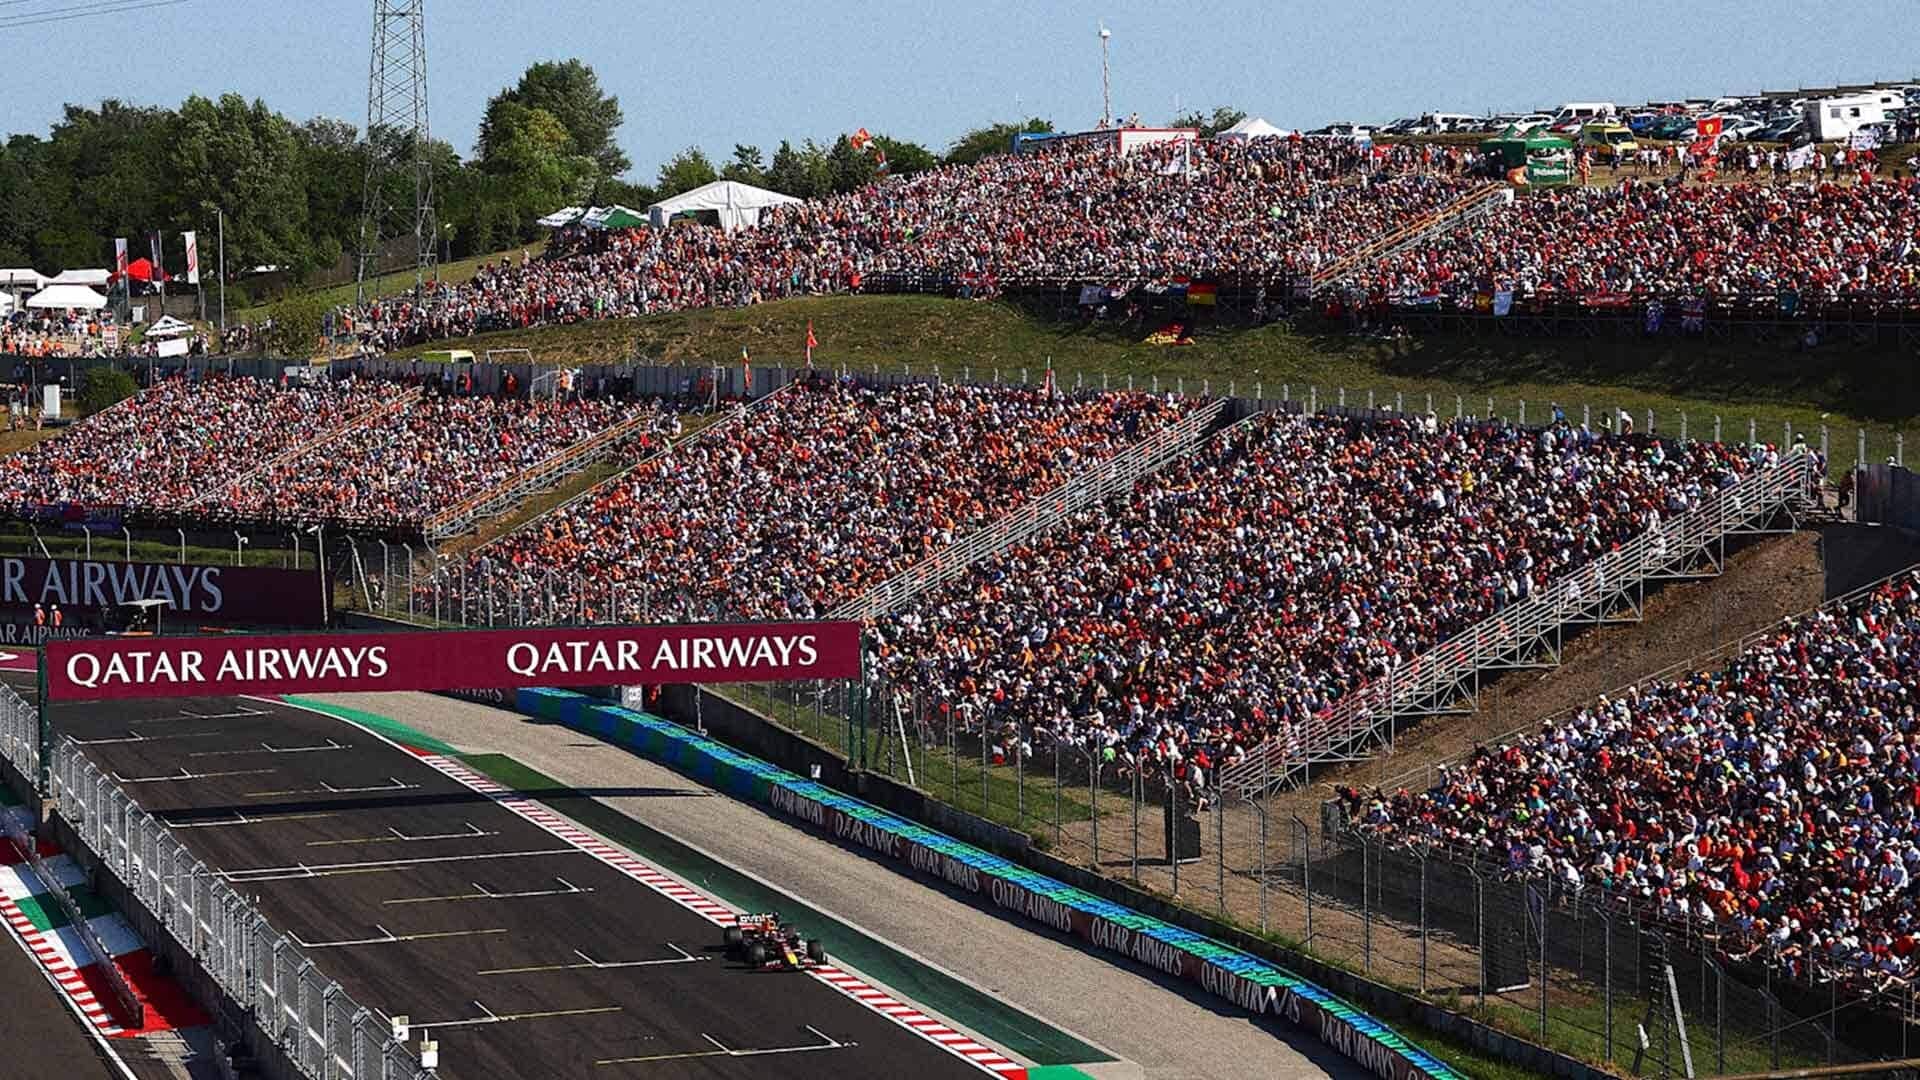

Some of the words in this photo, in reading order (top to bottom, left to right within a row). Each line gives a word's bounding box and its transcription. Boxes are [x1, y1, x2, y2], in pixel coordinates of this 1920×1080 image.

[40, 560, 223, 613] AIRWAYS
[67, 650, 205, 687] QATAR
[216, 646, 388, 681] AIRWAYS
[506, 640, 640, 676] QATAR
[651, 635, 817, 670] AIRWAYS
[1091, 917, 1129, 956] QATAR
[1131, 933, 1184, 977] AIRWAYS
